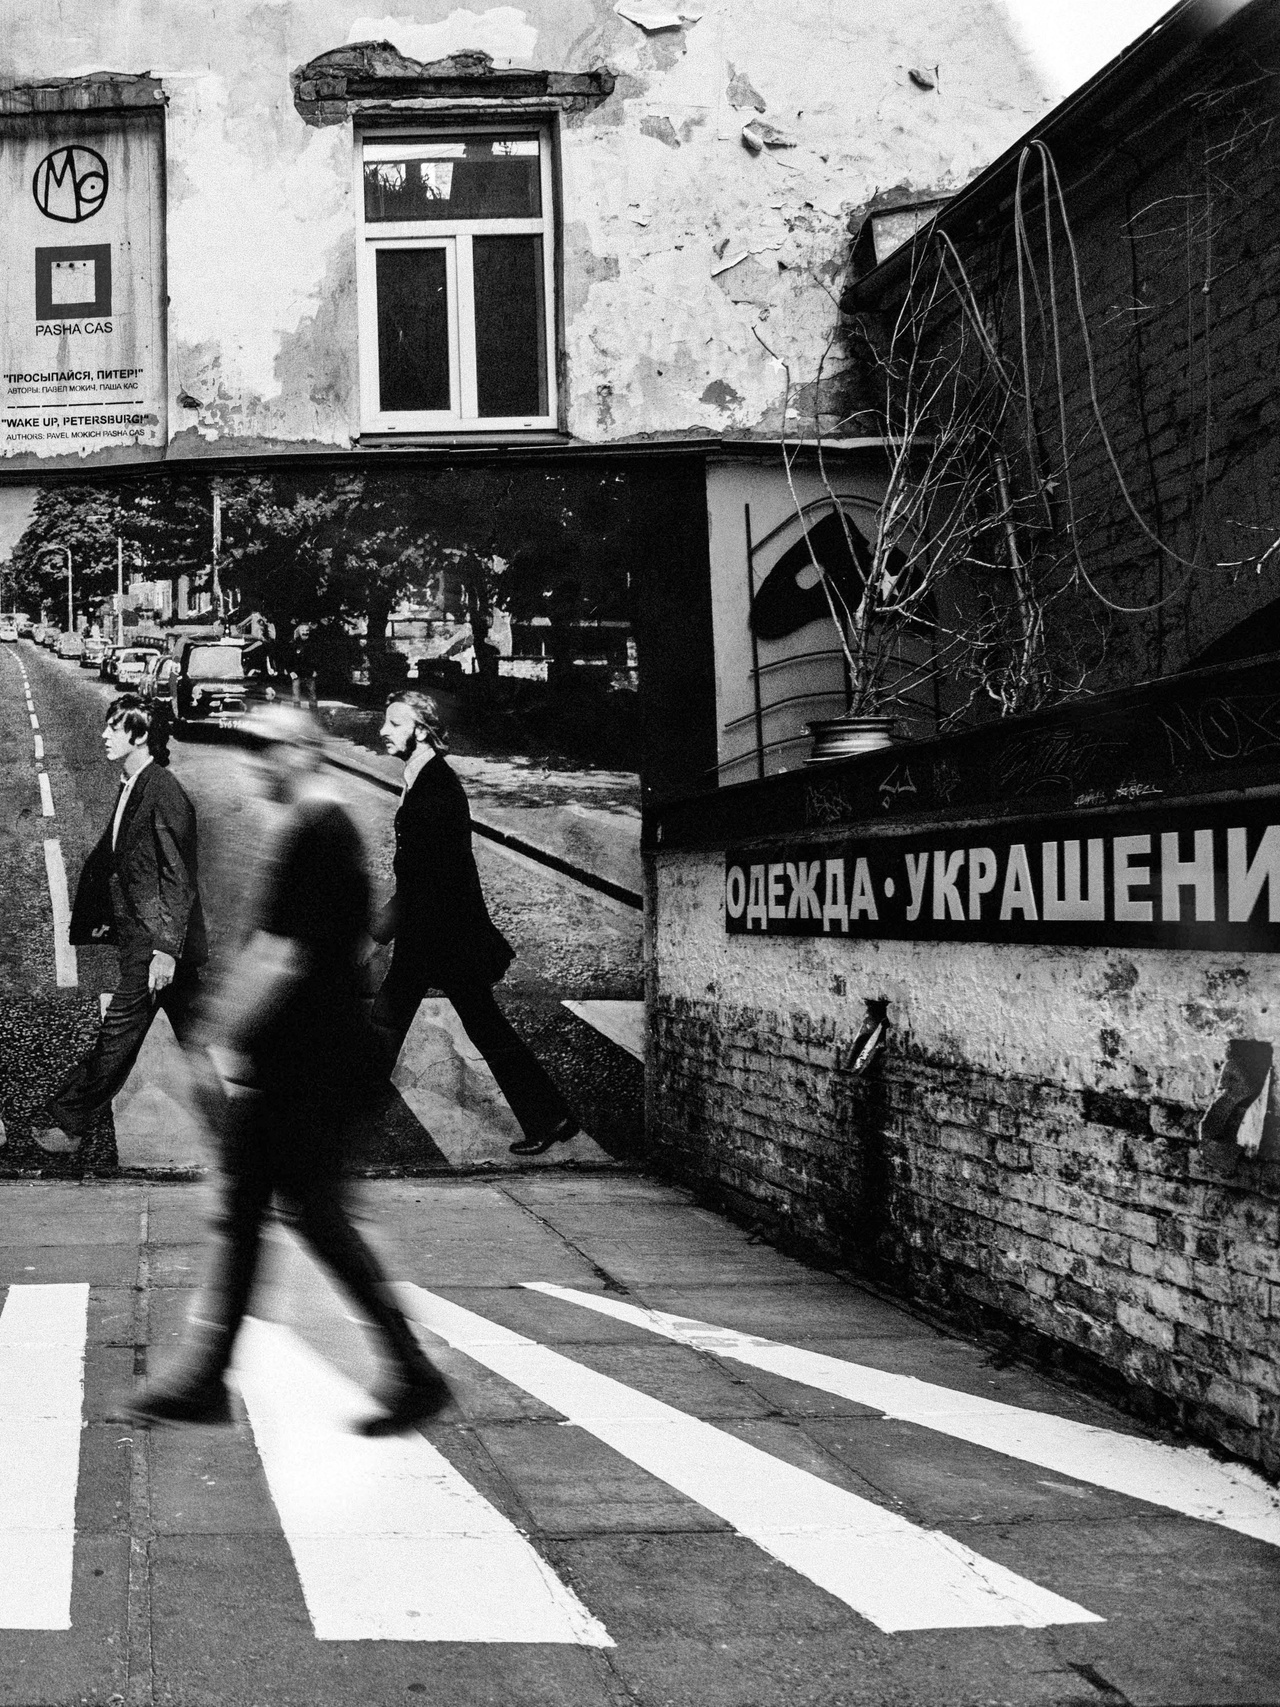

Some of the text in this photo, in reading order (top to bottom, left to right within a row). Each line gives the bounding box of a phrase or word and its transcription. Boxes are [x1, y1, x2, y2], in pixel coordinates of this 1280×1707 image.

[35, 321, 113, 336] PASHA CAS
[3, 368, 144, 383] "ПРОСЫПАЙСЯ, ПИТЕР!"
[7, 386, 40, 394] АВТОРЫ:
[42, 385, 67, 393] ПАВЕЛ
[100, 383, 122, 391] ПАША
[123, 382, 138, 390] КАС
[1, 414, 149, 427] "WAKE UP, PETERSBURG!"
[103, 429, 127, 437] PASHA
[129, 428, 145, 437] CAS
[726, 824, 1280, 932] ОДЕЖДА УКРАШЕНИ
